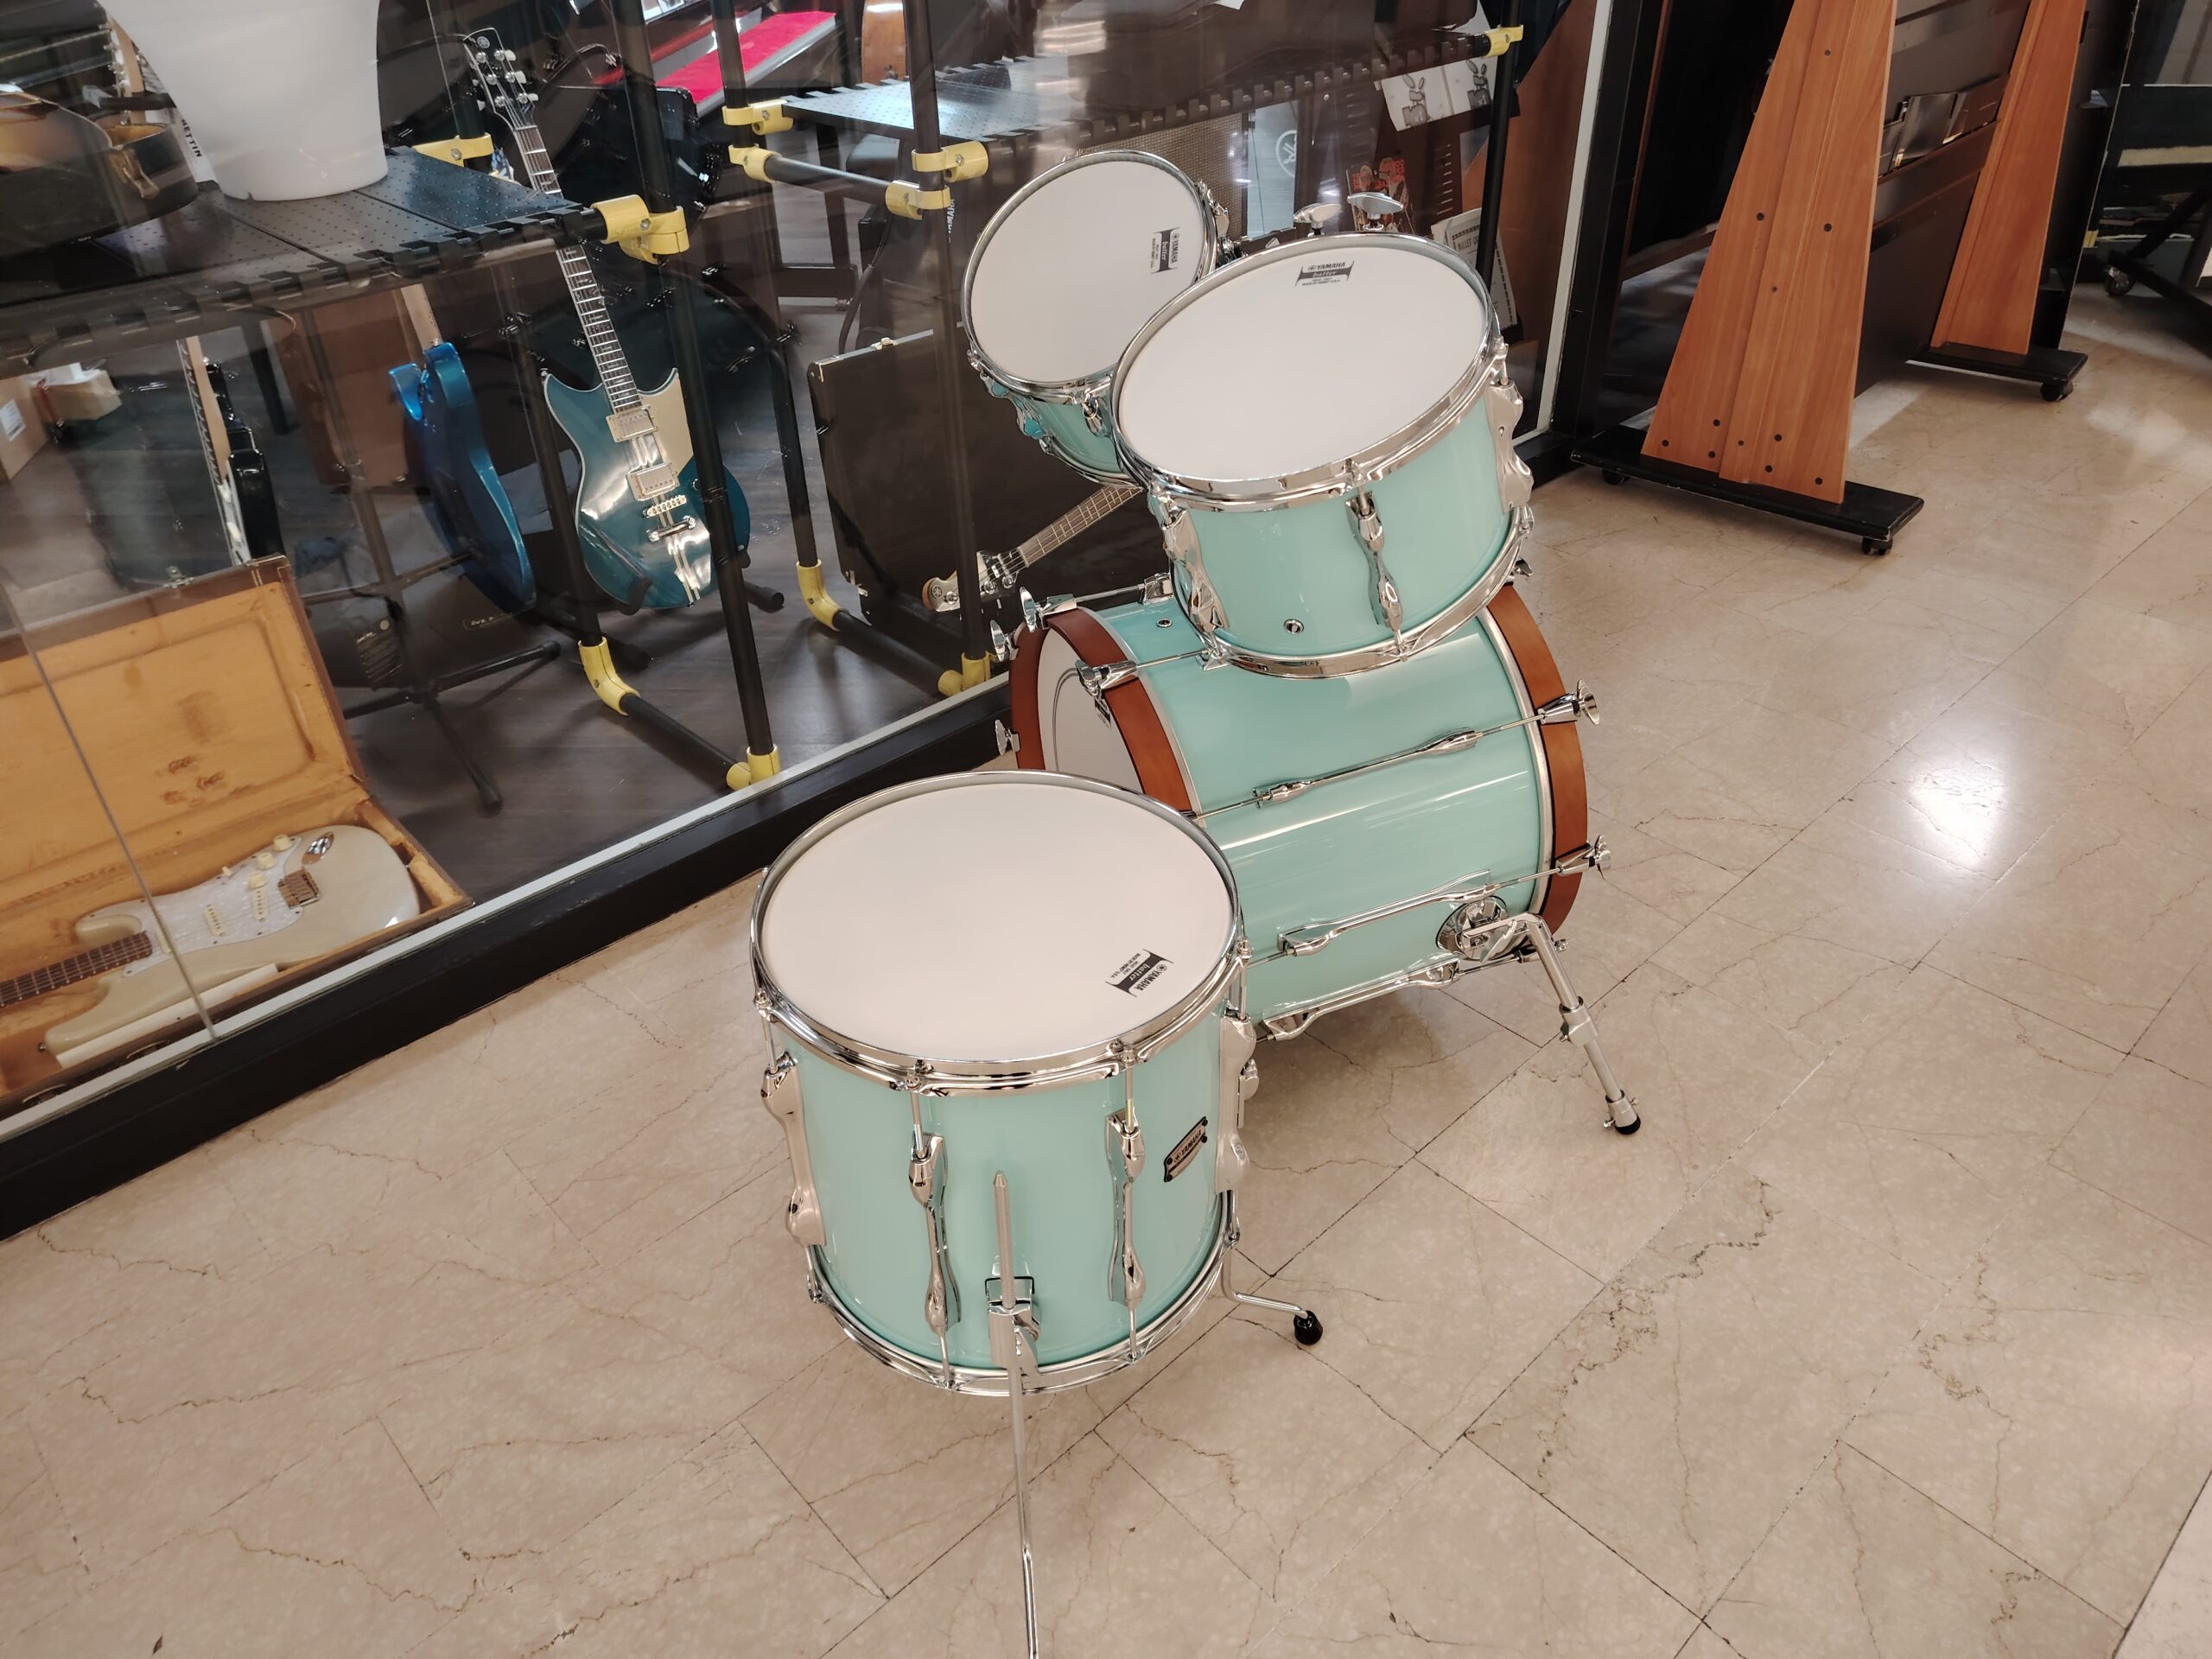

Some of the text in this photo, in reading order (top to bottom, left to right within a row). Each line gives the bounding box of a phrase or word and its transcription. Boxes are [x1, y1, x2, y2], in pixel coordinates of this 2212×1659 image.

[1128, 963, 1151, 981] batter
[1134, 969, 1162, 991] YAMAHA
[1181, 1128, 1202, 1155] YAMAHA
